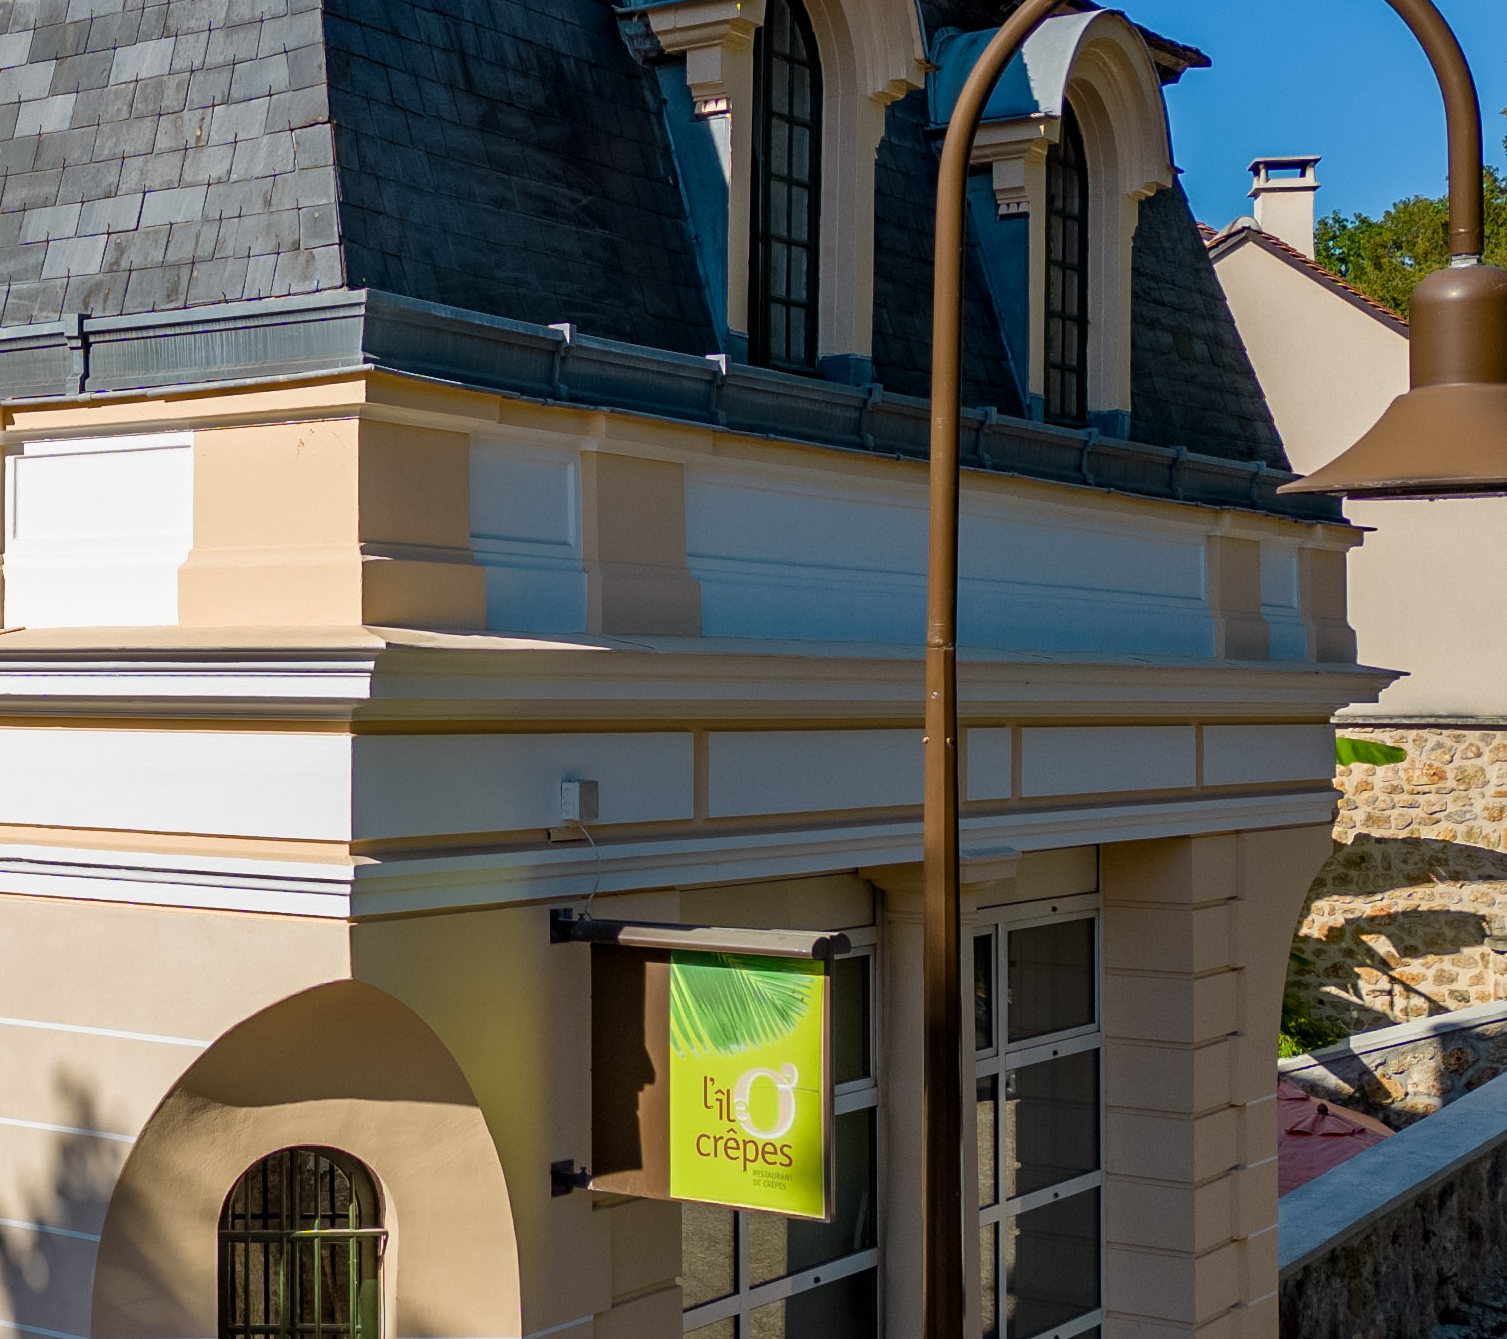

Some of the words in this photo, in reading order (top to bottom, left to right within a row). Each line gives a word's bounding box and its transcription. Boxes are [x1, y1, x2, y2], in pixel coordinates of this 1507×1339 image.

[696, 1128, 793, 1173] crêpes
[753, 1170, 792, 1181] RESTAURANT
[753, 1179, 761, 1187] DE
